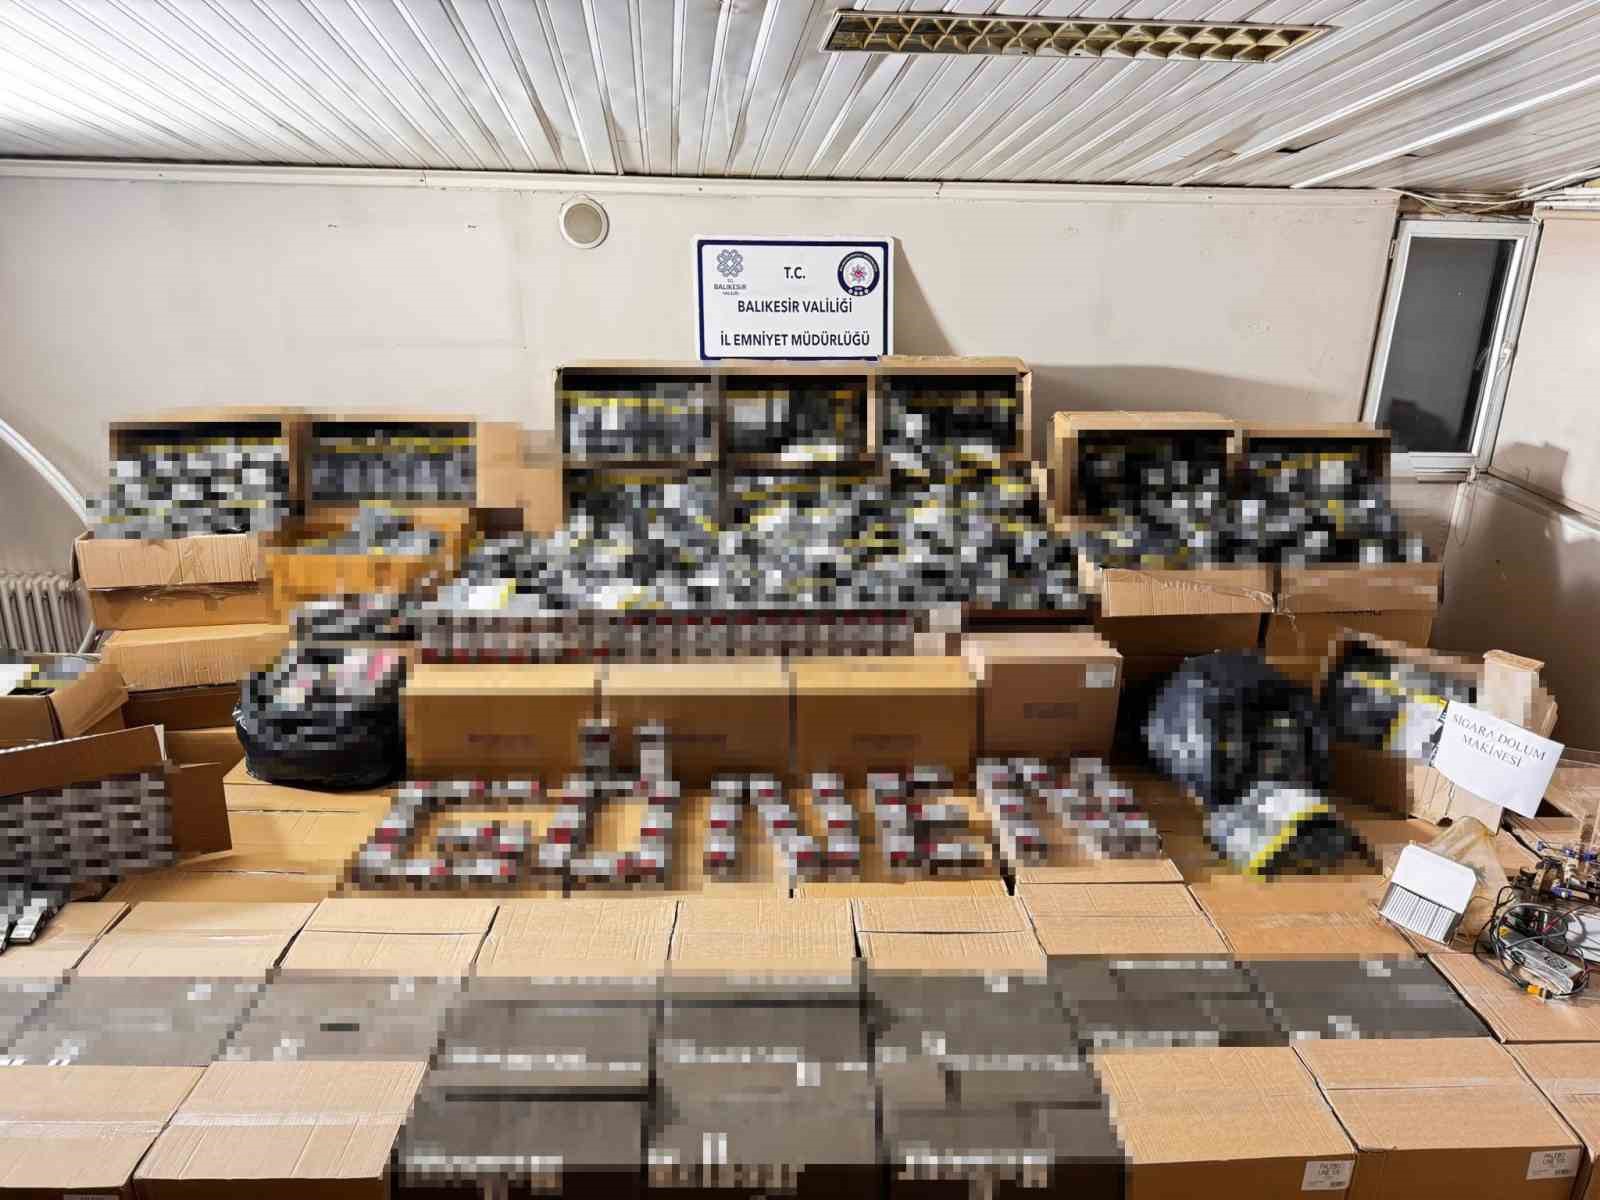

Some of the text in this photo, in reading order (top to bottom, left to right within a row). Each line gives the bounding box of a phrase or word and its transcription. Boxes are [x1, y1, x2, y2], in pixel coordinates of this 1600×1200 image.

[784, 267, 806, 279] T.C.
[738, 297, 852, 313] BALIKESİR VALİLİĞİ
[721, 330, 870, 346] İL EMNİYET MÜDÜRLÜĞÜ
[1453, 713, 1546, 761] SİGARA DOLUM
[1463, 734, 1522, 768] MAKİNESİ
